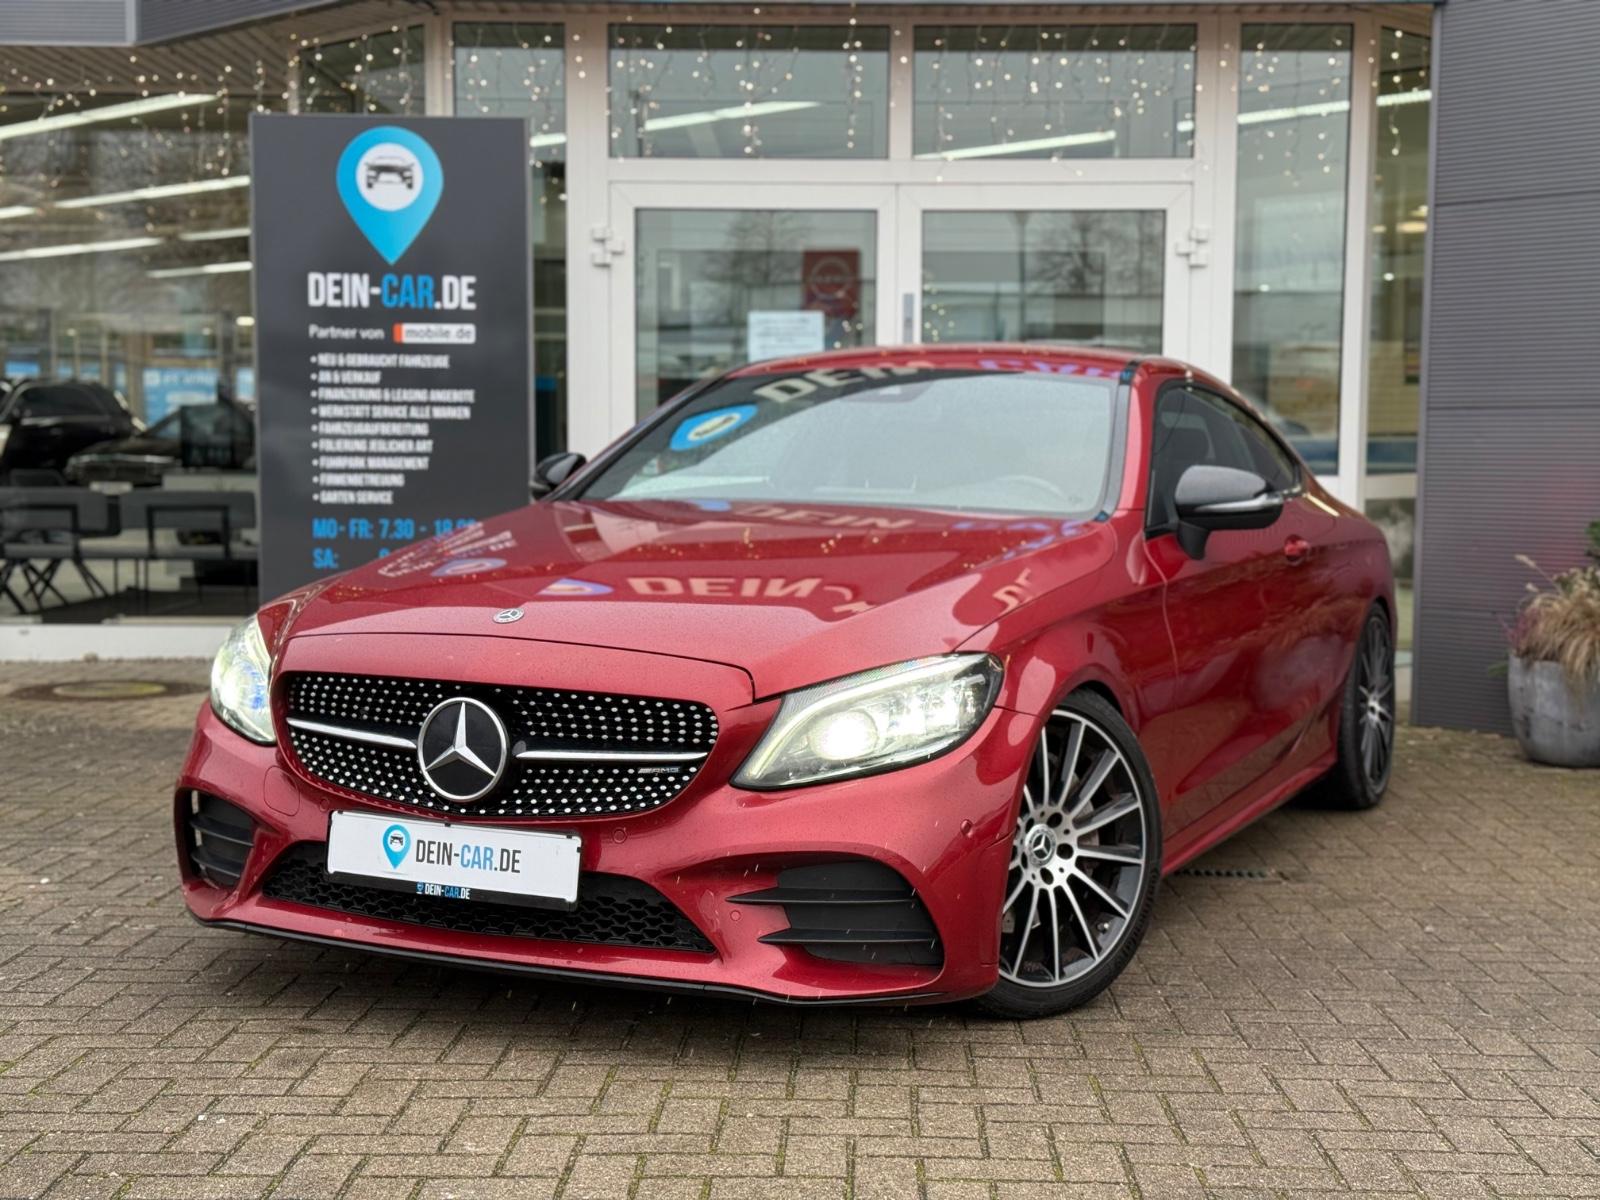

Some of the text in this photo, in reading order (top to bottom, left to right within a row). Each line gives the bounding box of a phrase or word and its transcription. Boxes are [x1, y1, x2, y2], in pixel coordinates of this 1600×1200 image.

[307, 271, 477, 310] DEIN-CAR.DE
[308, 324, 385, 340] Partner von
[405, 326, 473, 339] mobile.de
[349, 518, 374, 539] FR:
[379, 518, 415, 539] 7.30
[313, 548, 338, 569] SA:
[415, 839, 522, 874] DEIN-CAR.DE
[424, 882, 471, 900] DEIN-CAR.DE
